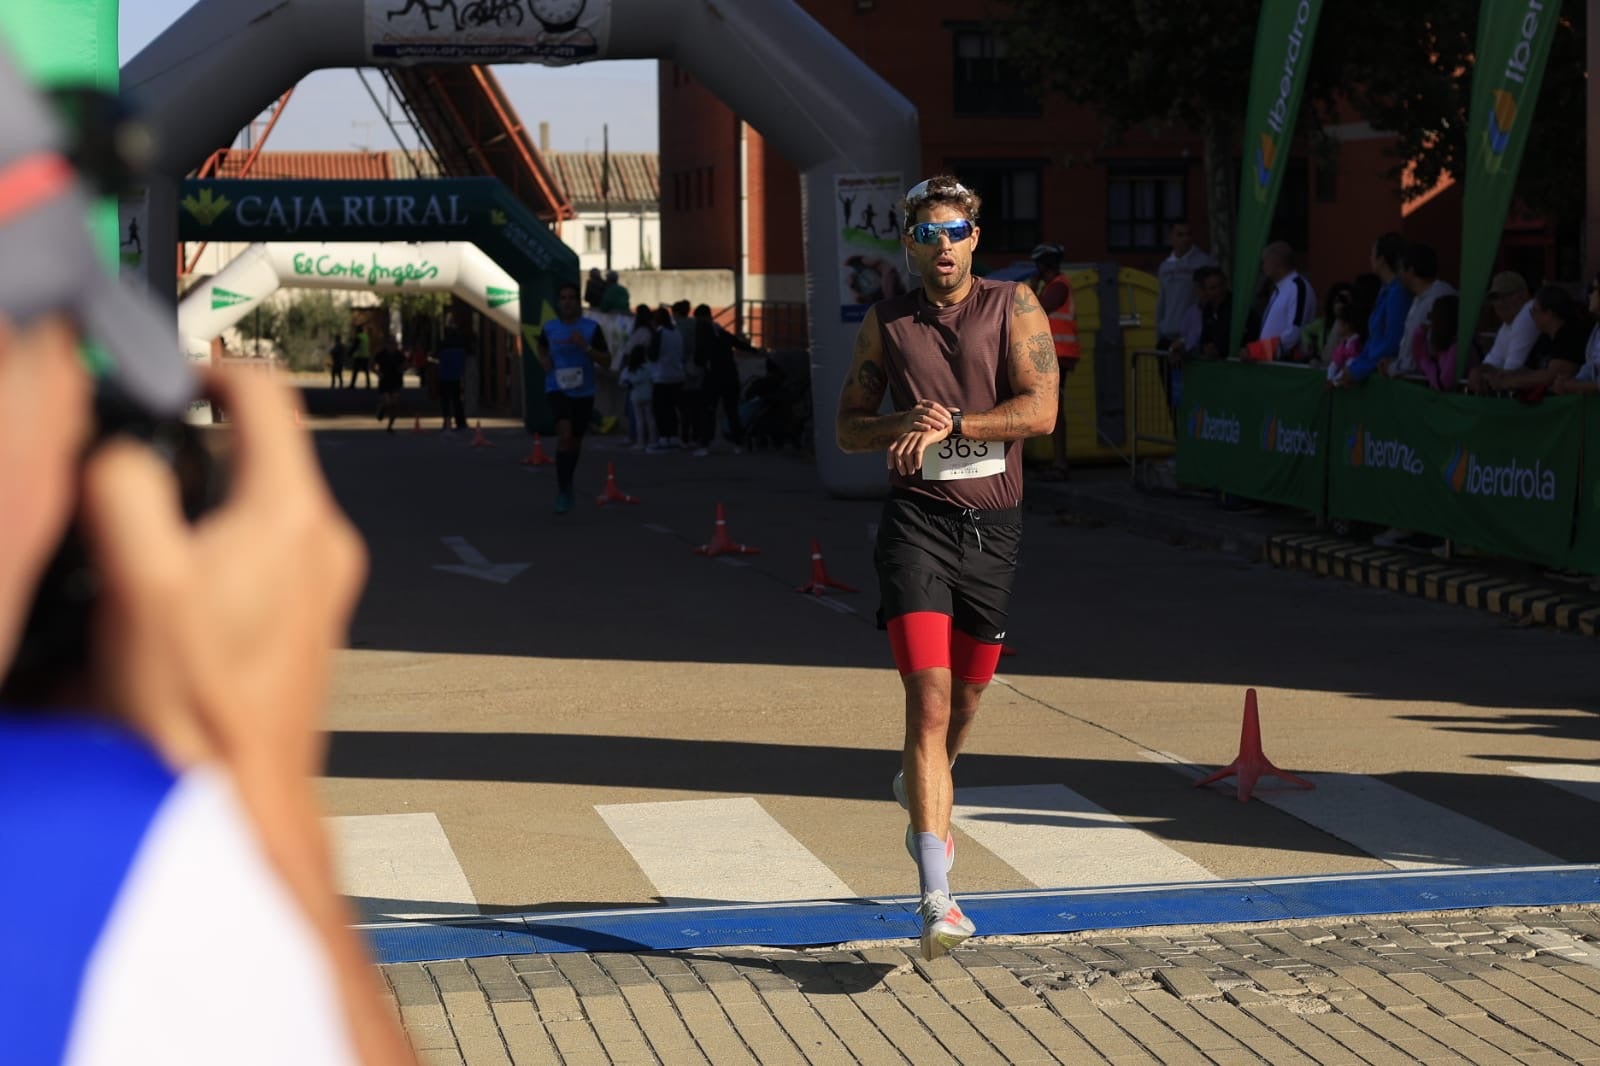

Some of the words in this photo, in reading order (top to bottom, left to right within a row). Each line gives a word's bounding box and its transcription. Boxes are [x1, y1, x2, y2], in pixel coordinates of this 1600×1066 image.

[234, 195, 329, 232] CAJA
[343, 195, 470, 227] RURAL
[293, 252, 313, 274] El
[316, 254, 365, 278] Corte
[367, 252, 438, 286] Inglés
[938, 438, 988, 460] 363
[1466, 452, 1556, 501] Iberdrola
